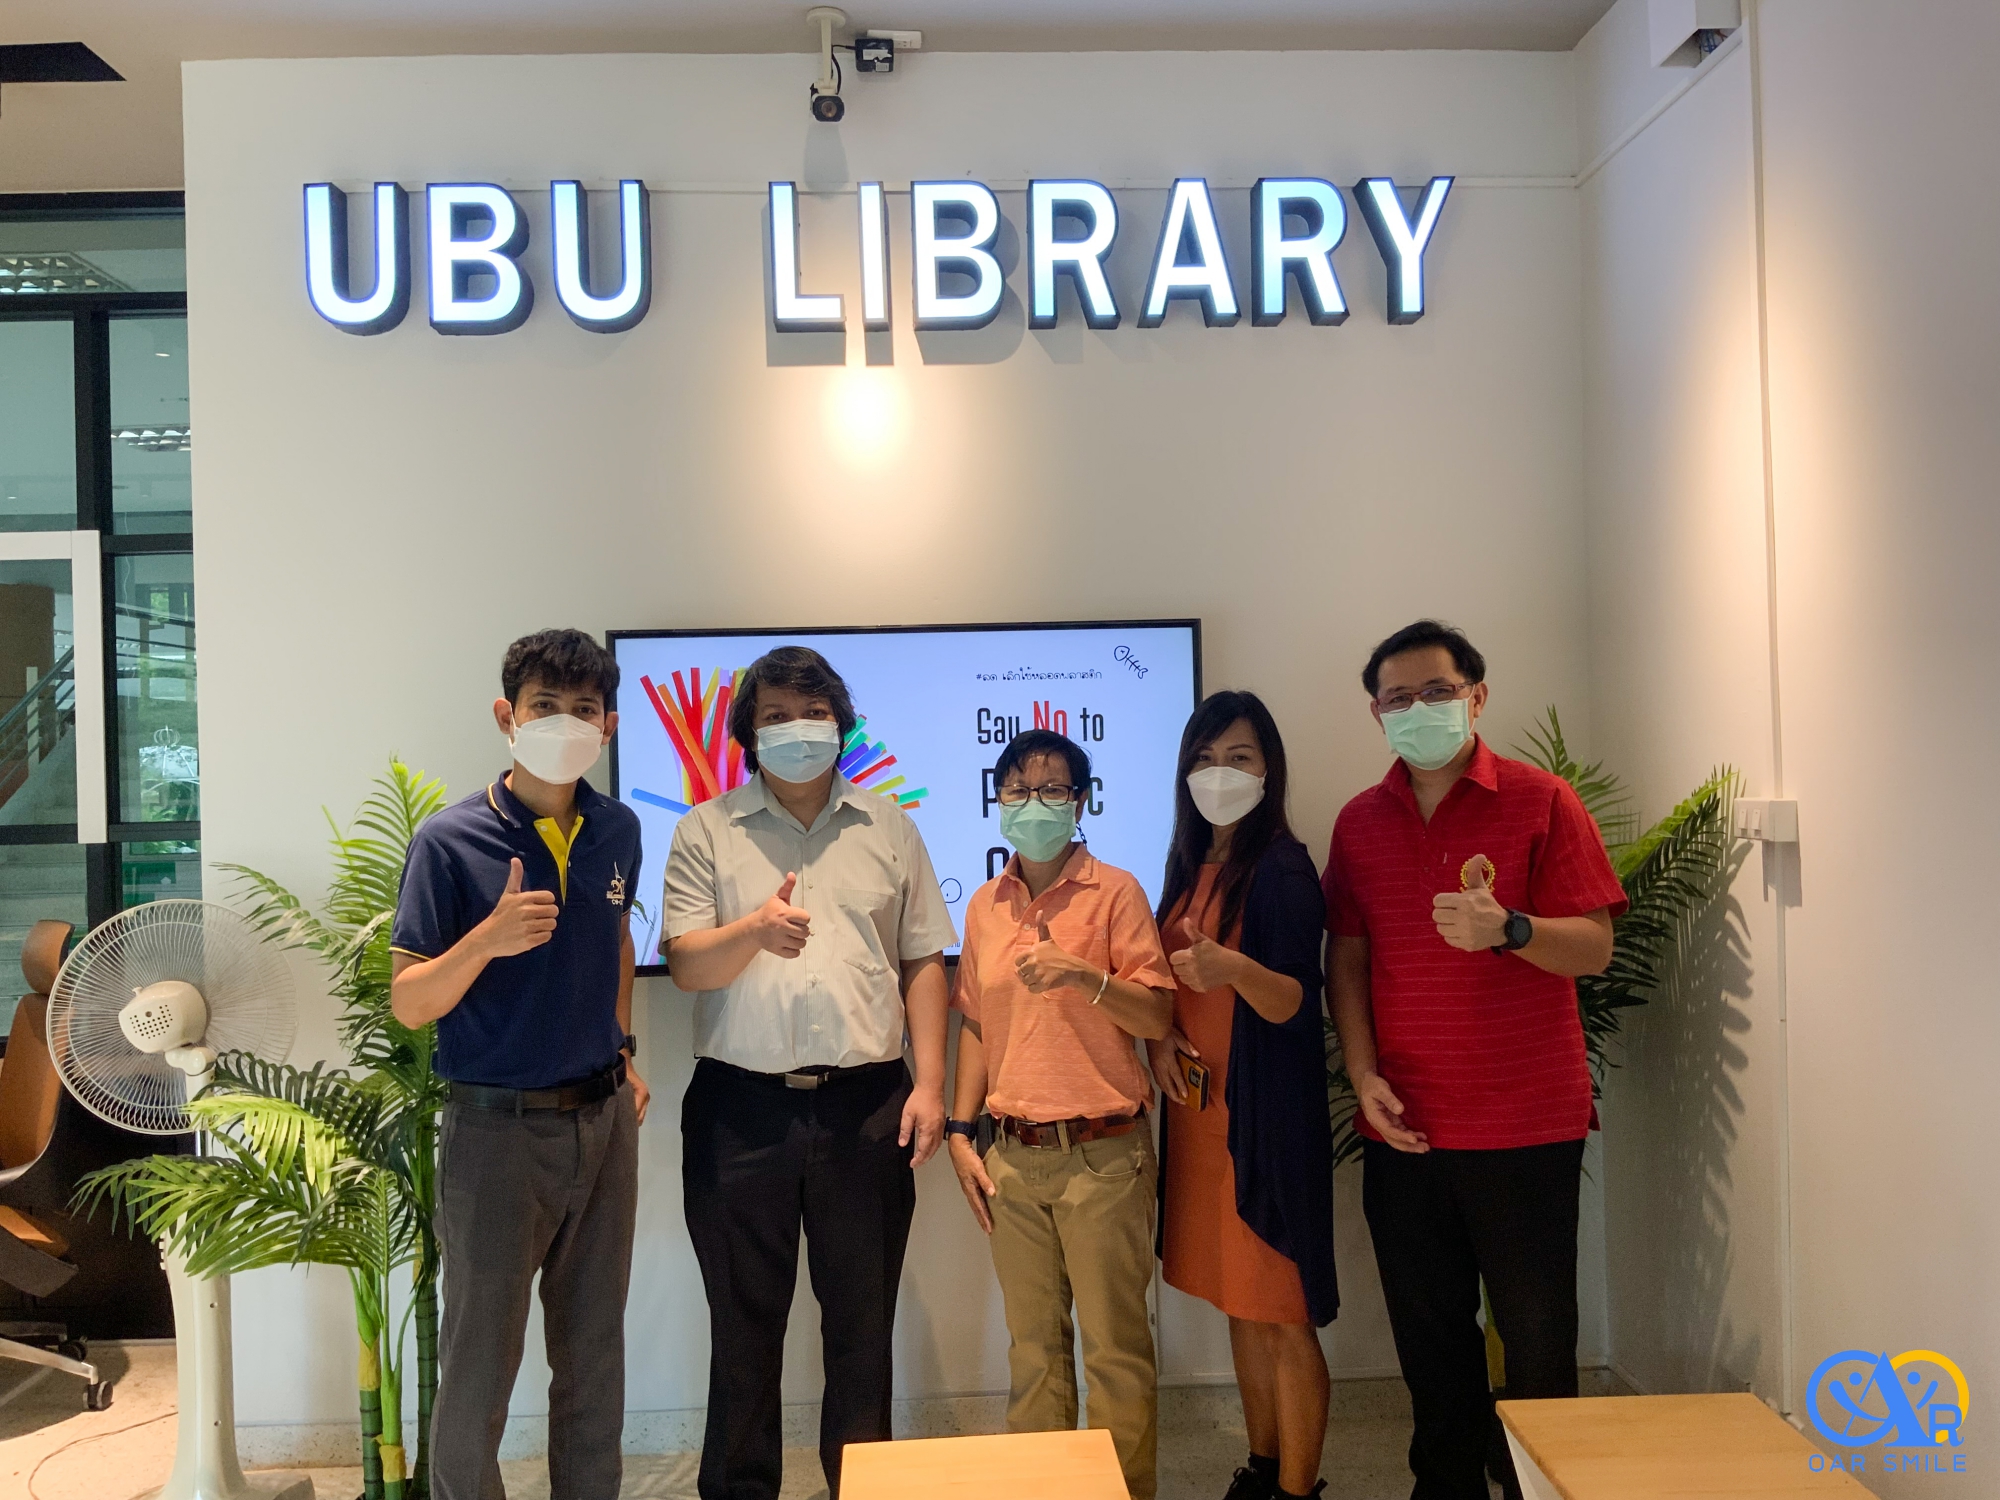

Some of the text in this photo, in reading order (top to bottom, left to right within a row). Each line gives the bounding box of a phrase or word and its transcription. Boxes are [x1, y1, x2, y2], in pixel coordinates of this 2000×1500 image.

[303, 176, 1455, 332] UBU LIBRARY
[1033, 700, 1068, 738] No
[1080, 707, 1104, 742] to
